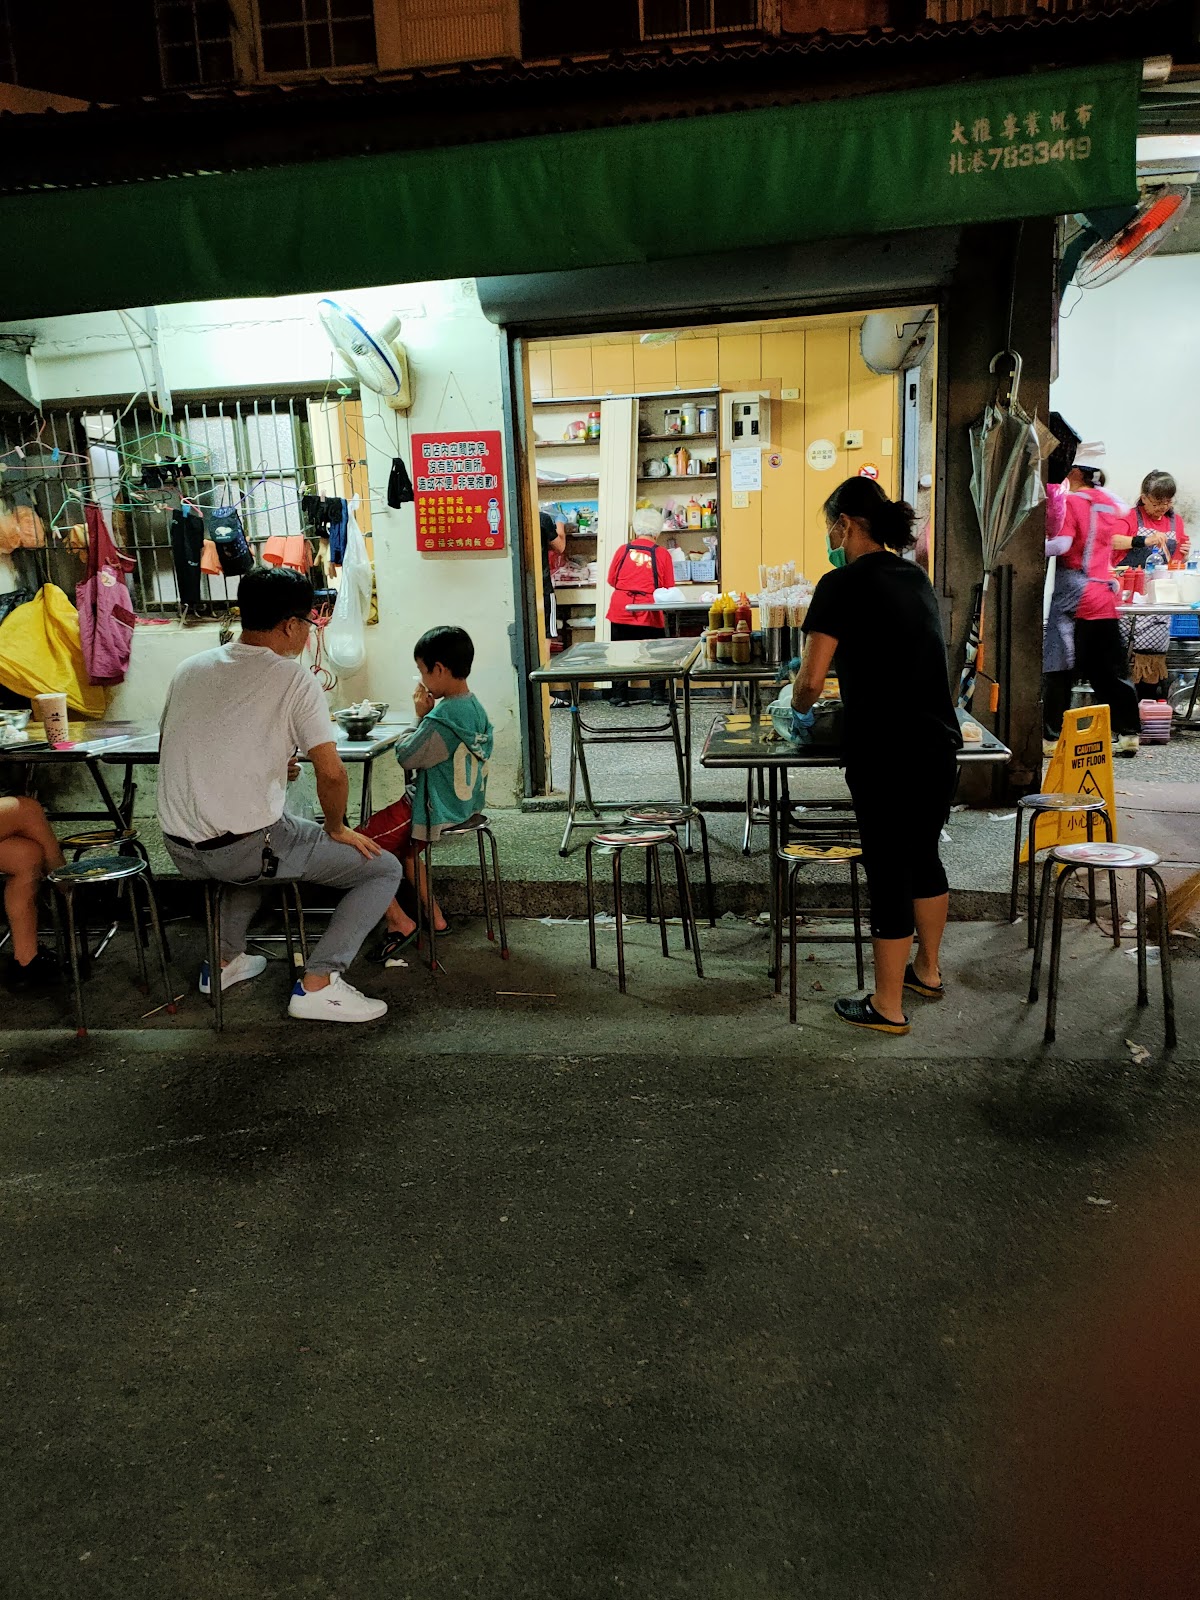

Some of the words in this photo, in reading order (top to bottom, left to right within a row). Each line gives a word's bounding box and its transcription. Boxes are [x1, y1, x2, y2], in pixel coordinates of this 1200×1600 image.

[1076, 742, 1101, 755] CAUTION
[1071, 757, 1085, 769] WET
[1086, 754, 1106, 767] FLOOR
